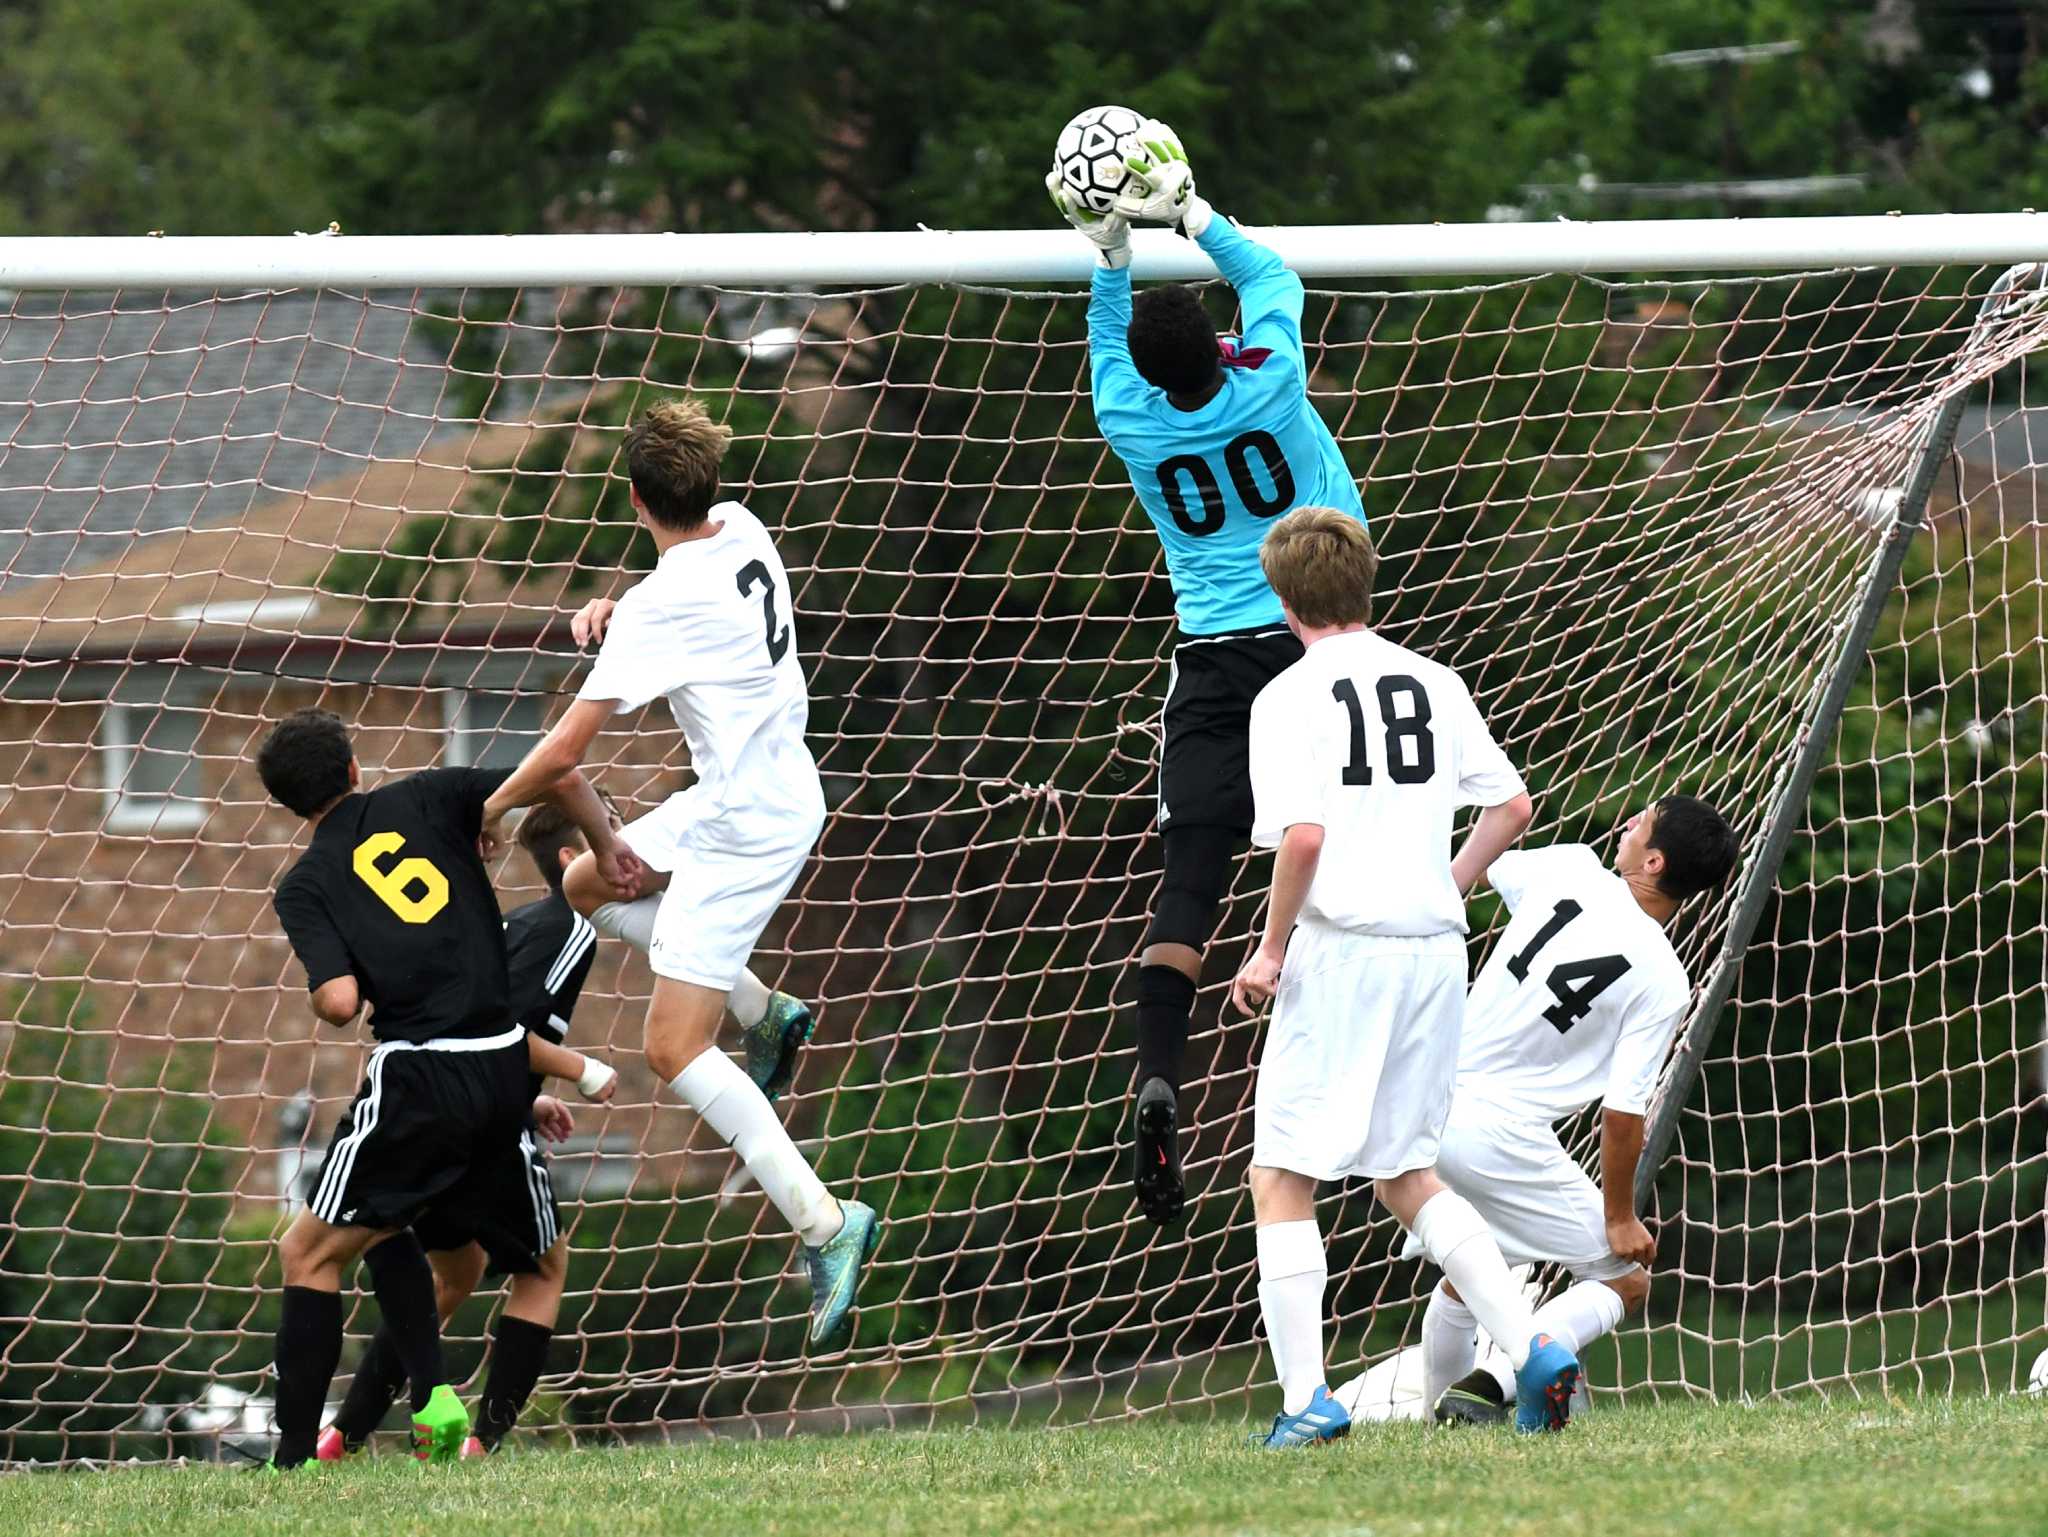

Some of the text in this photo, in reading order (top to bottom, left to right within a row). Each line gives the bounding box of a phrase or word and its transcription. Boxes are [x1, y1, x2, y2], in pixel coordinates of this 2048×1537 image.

[1156, 430, 1296, 537] 00
[736, 559, 789, 666] 2
[1332, 674, 1435, 785] 18
[353, 831, 449, 924] 6
[1507, 899, 1632, 1034] 14
